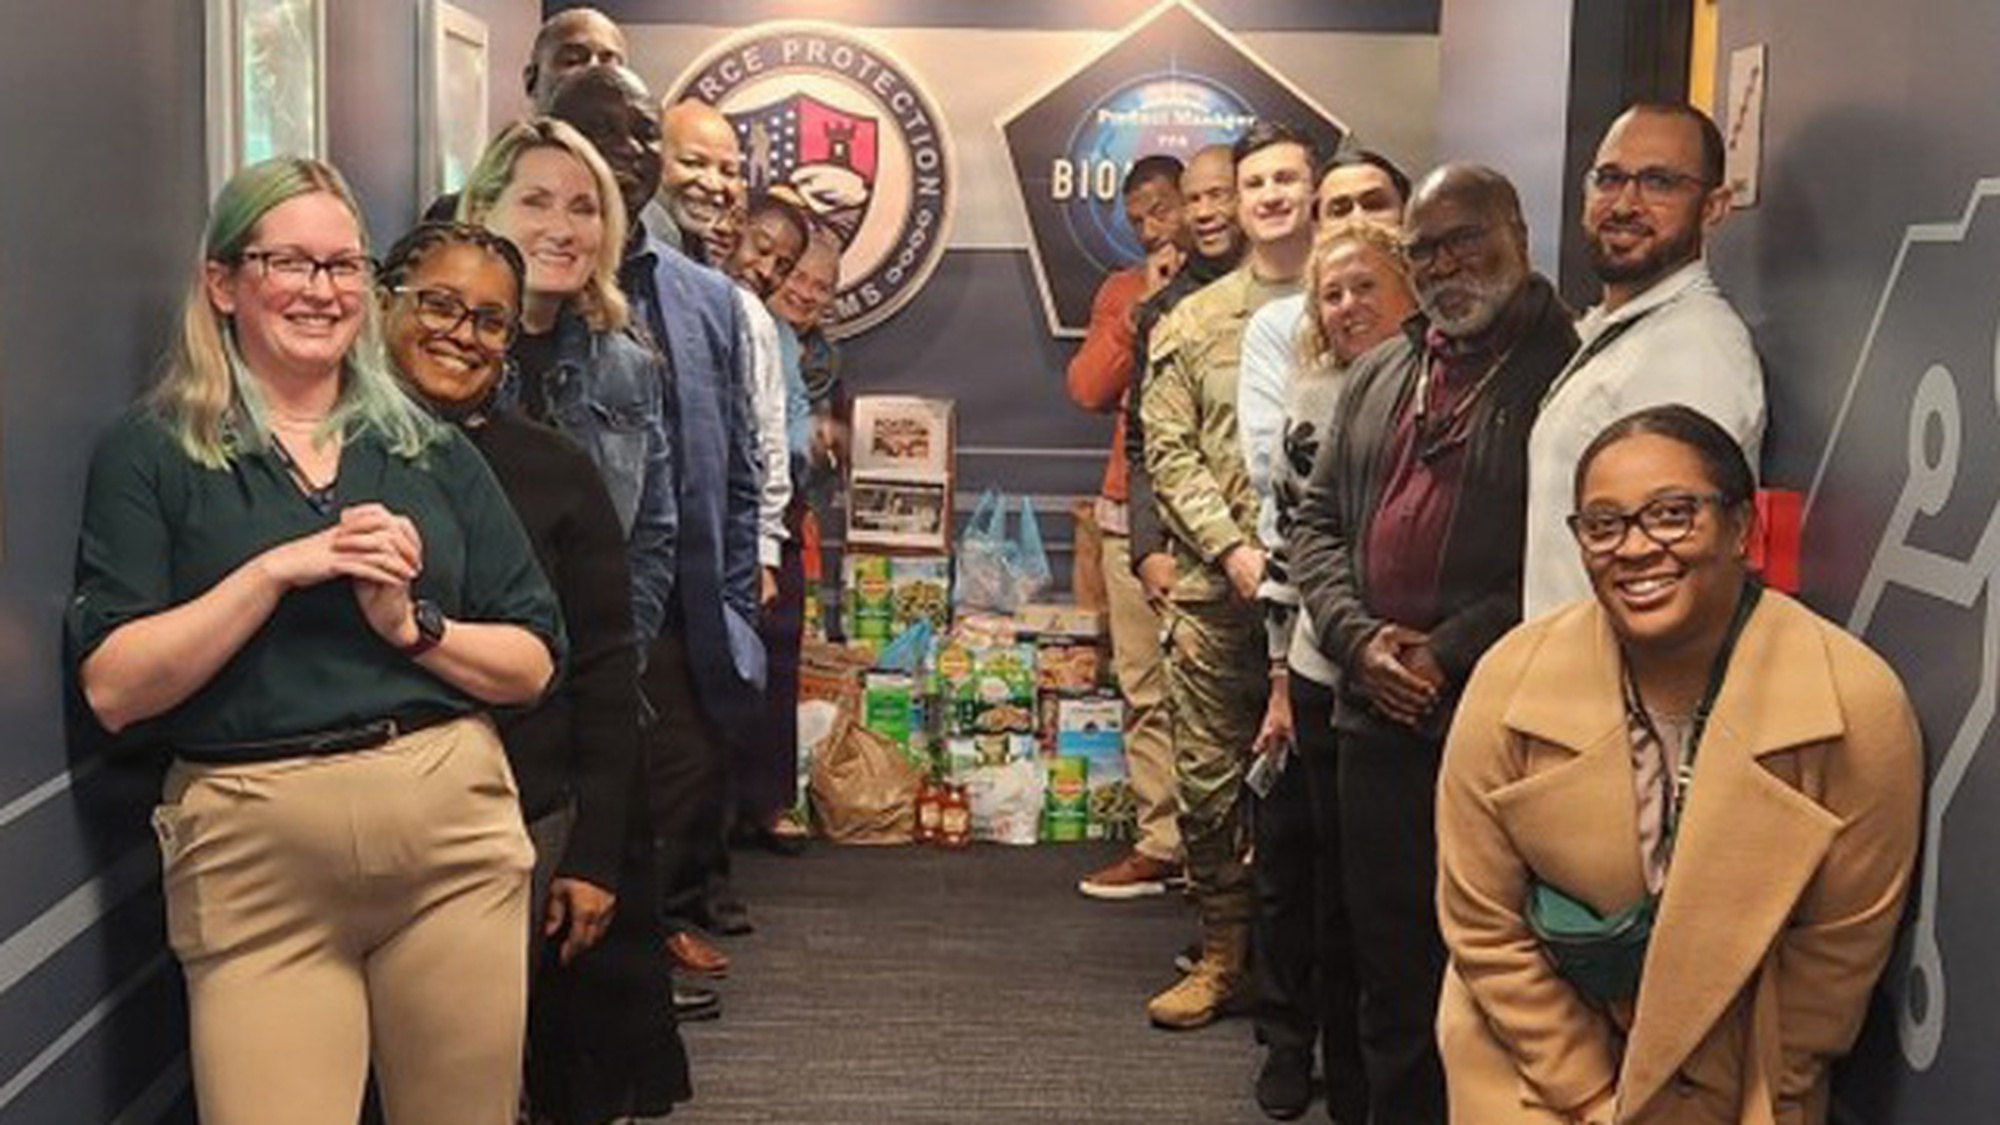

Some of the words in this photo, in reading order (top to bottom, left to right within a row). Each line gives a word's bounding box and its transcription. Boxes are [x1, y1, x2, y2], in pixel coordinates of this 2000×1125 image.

[699, 46, 764, 101] RCE
[782, 39, 940, 197] PROTECTION
[1172, 110, 1258, 130] Manager
[1052, 159, 1131, 199] BIO
